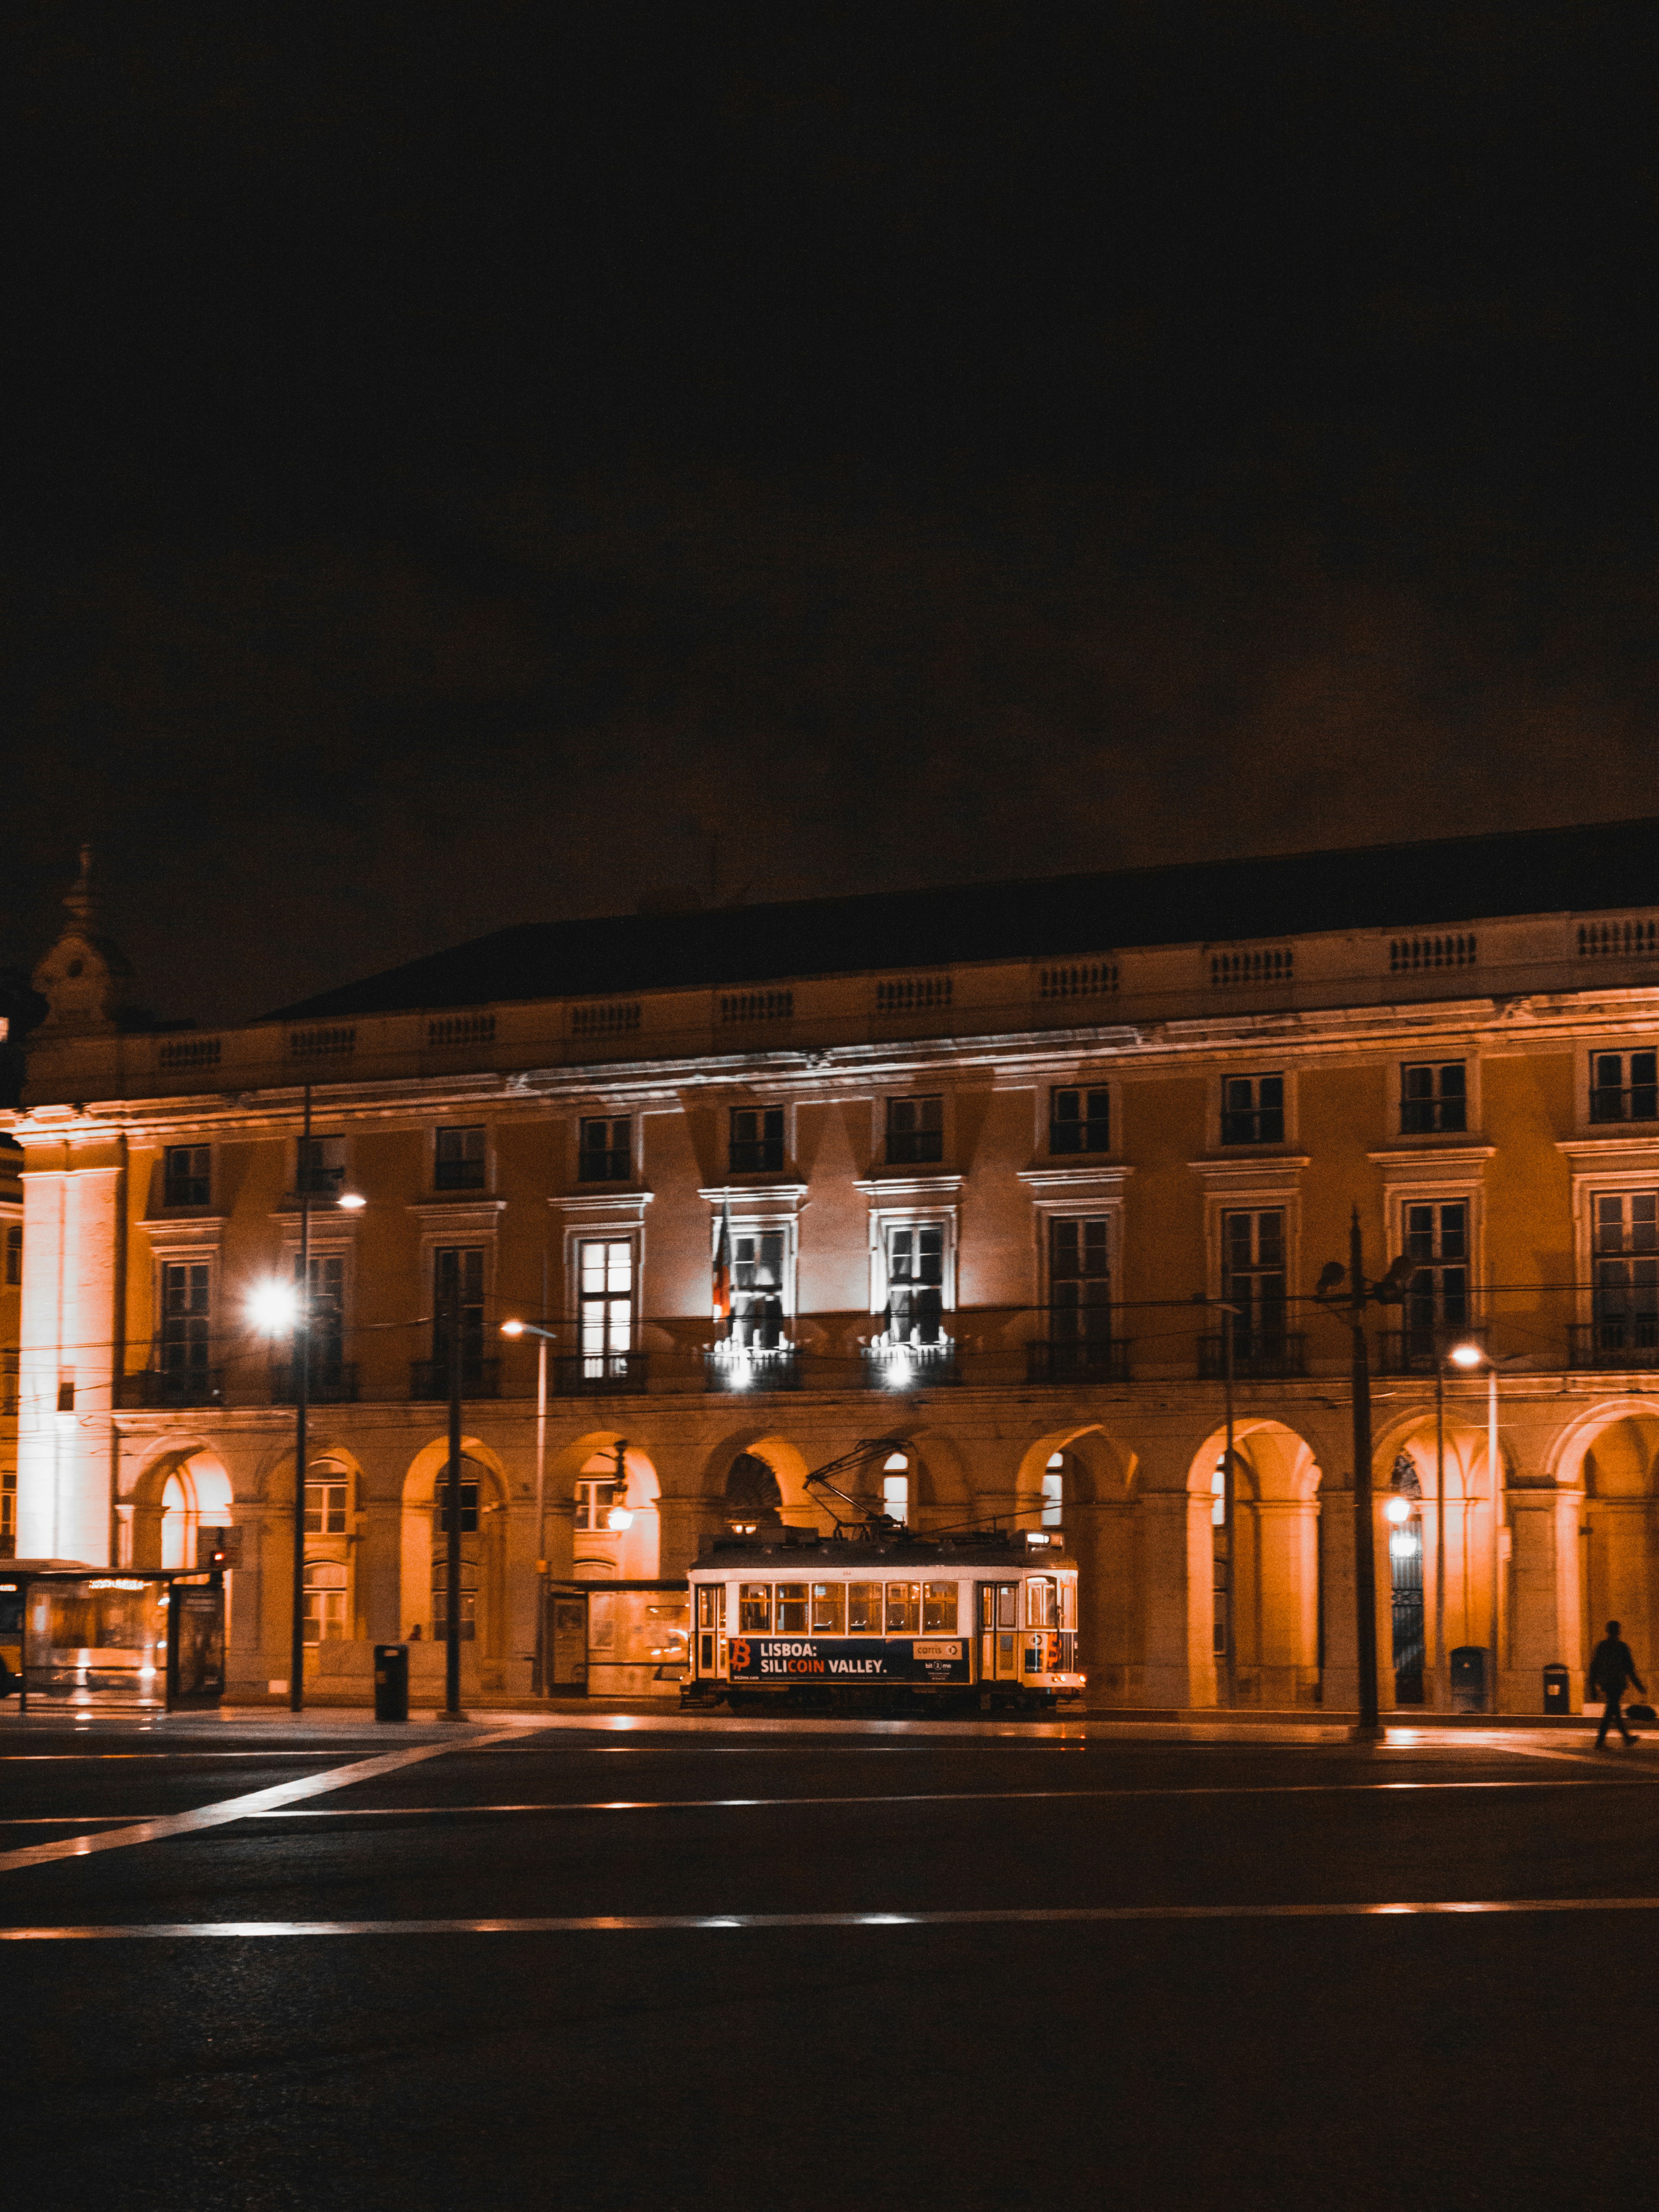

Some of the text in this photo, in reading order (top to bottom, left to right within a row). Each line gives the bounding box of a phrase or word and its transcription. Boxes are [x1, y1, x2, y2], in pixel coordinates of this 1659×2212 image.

[760, 1643, 817, 1657] LISBOA:
[917, 1645, 942, 1654] carris
[761, 1660, 887, 1673] SILICOIN VALLEY.
